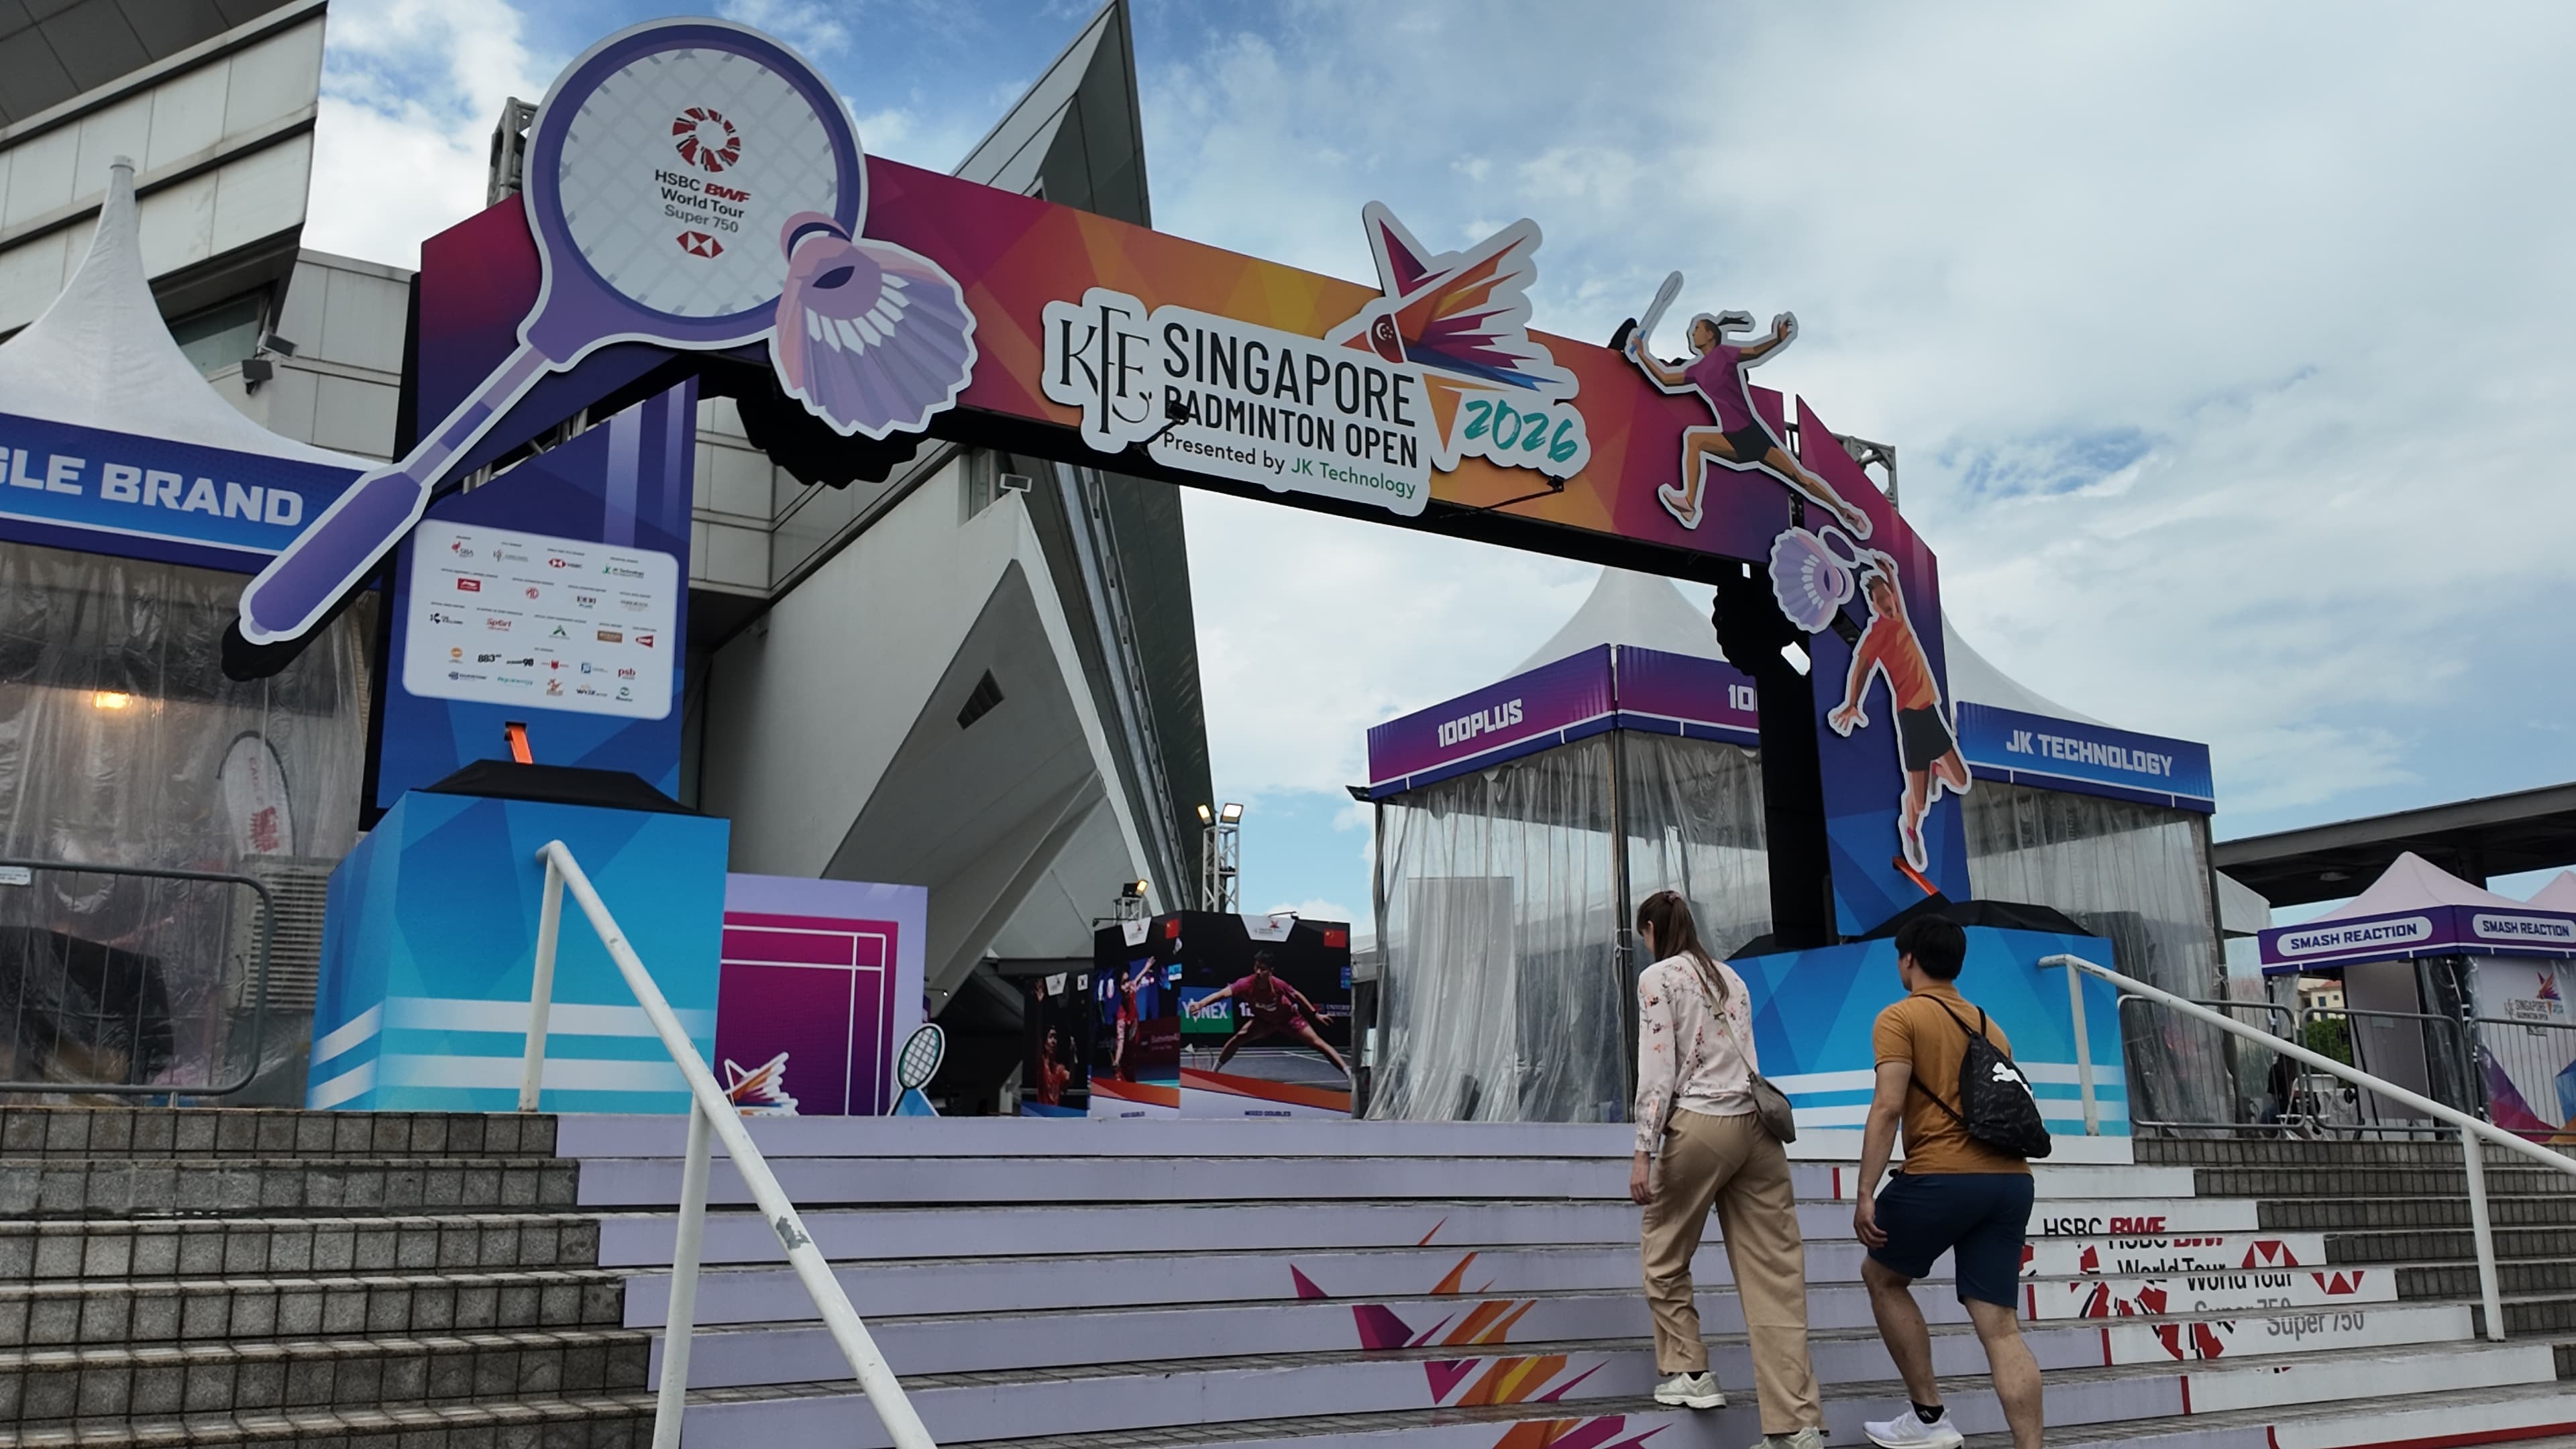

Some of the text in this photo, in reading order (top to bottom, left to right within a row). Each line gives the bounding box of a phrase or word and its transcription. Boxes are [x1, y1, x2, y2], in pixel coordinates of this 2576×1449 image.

[655, 170, 751, 203] HSBC BWF
[661, 186, 744, 219] World Tour
[664, 204, 739, 233] Super 750
[1163, 322, 1415, 427] SINGAPORE
[1165, 384, 1417, 468] BADMINTON OPEN
[1464, 399, 1578, 463] 2026
[1164, 431, 1416, 500] Presented by JK Technology
[0, 445, 303, 527] LE BRAND
[1727, 684, 1758, 712] 10
[1438, 698, 1523, 747] 100PLUS
[2006, 729, 2173, 777] JK TECHNOLOGY
[2291, 923, 2418, 950] SMASH REACTION
[2483, 920, 2570, 936] SMASH REACTION
[2043, 1216, 2166, 1236] HSBC BWF
[2267, 1314, 2325, 1341] Super
